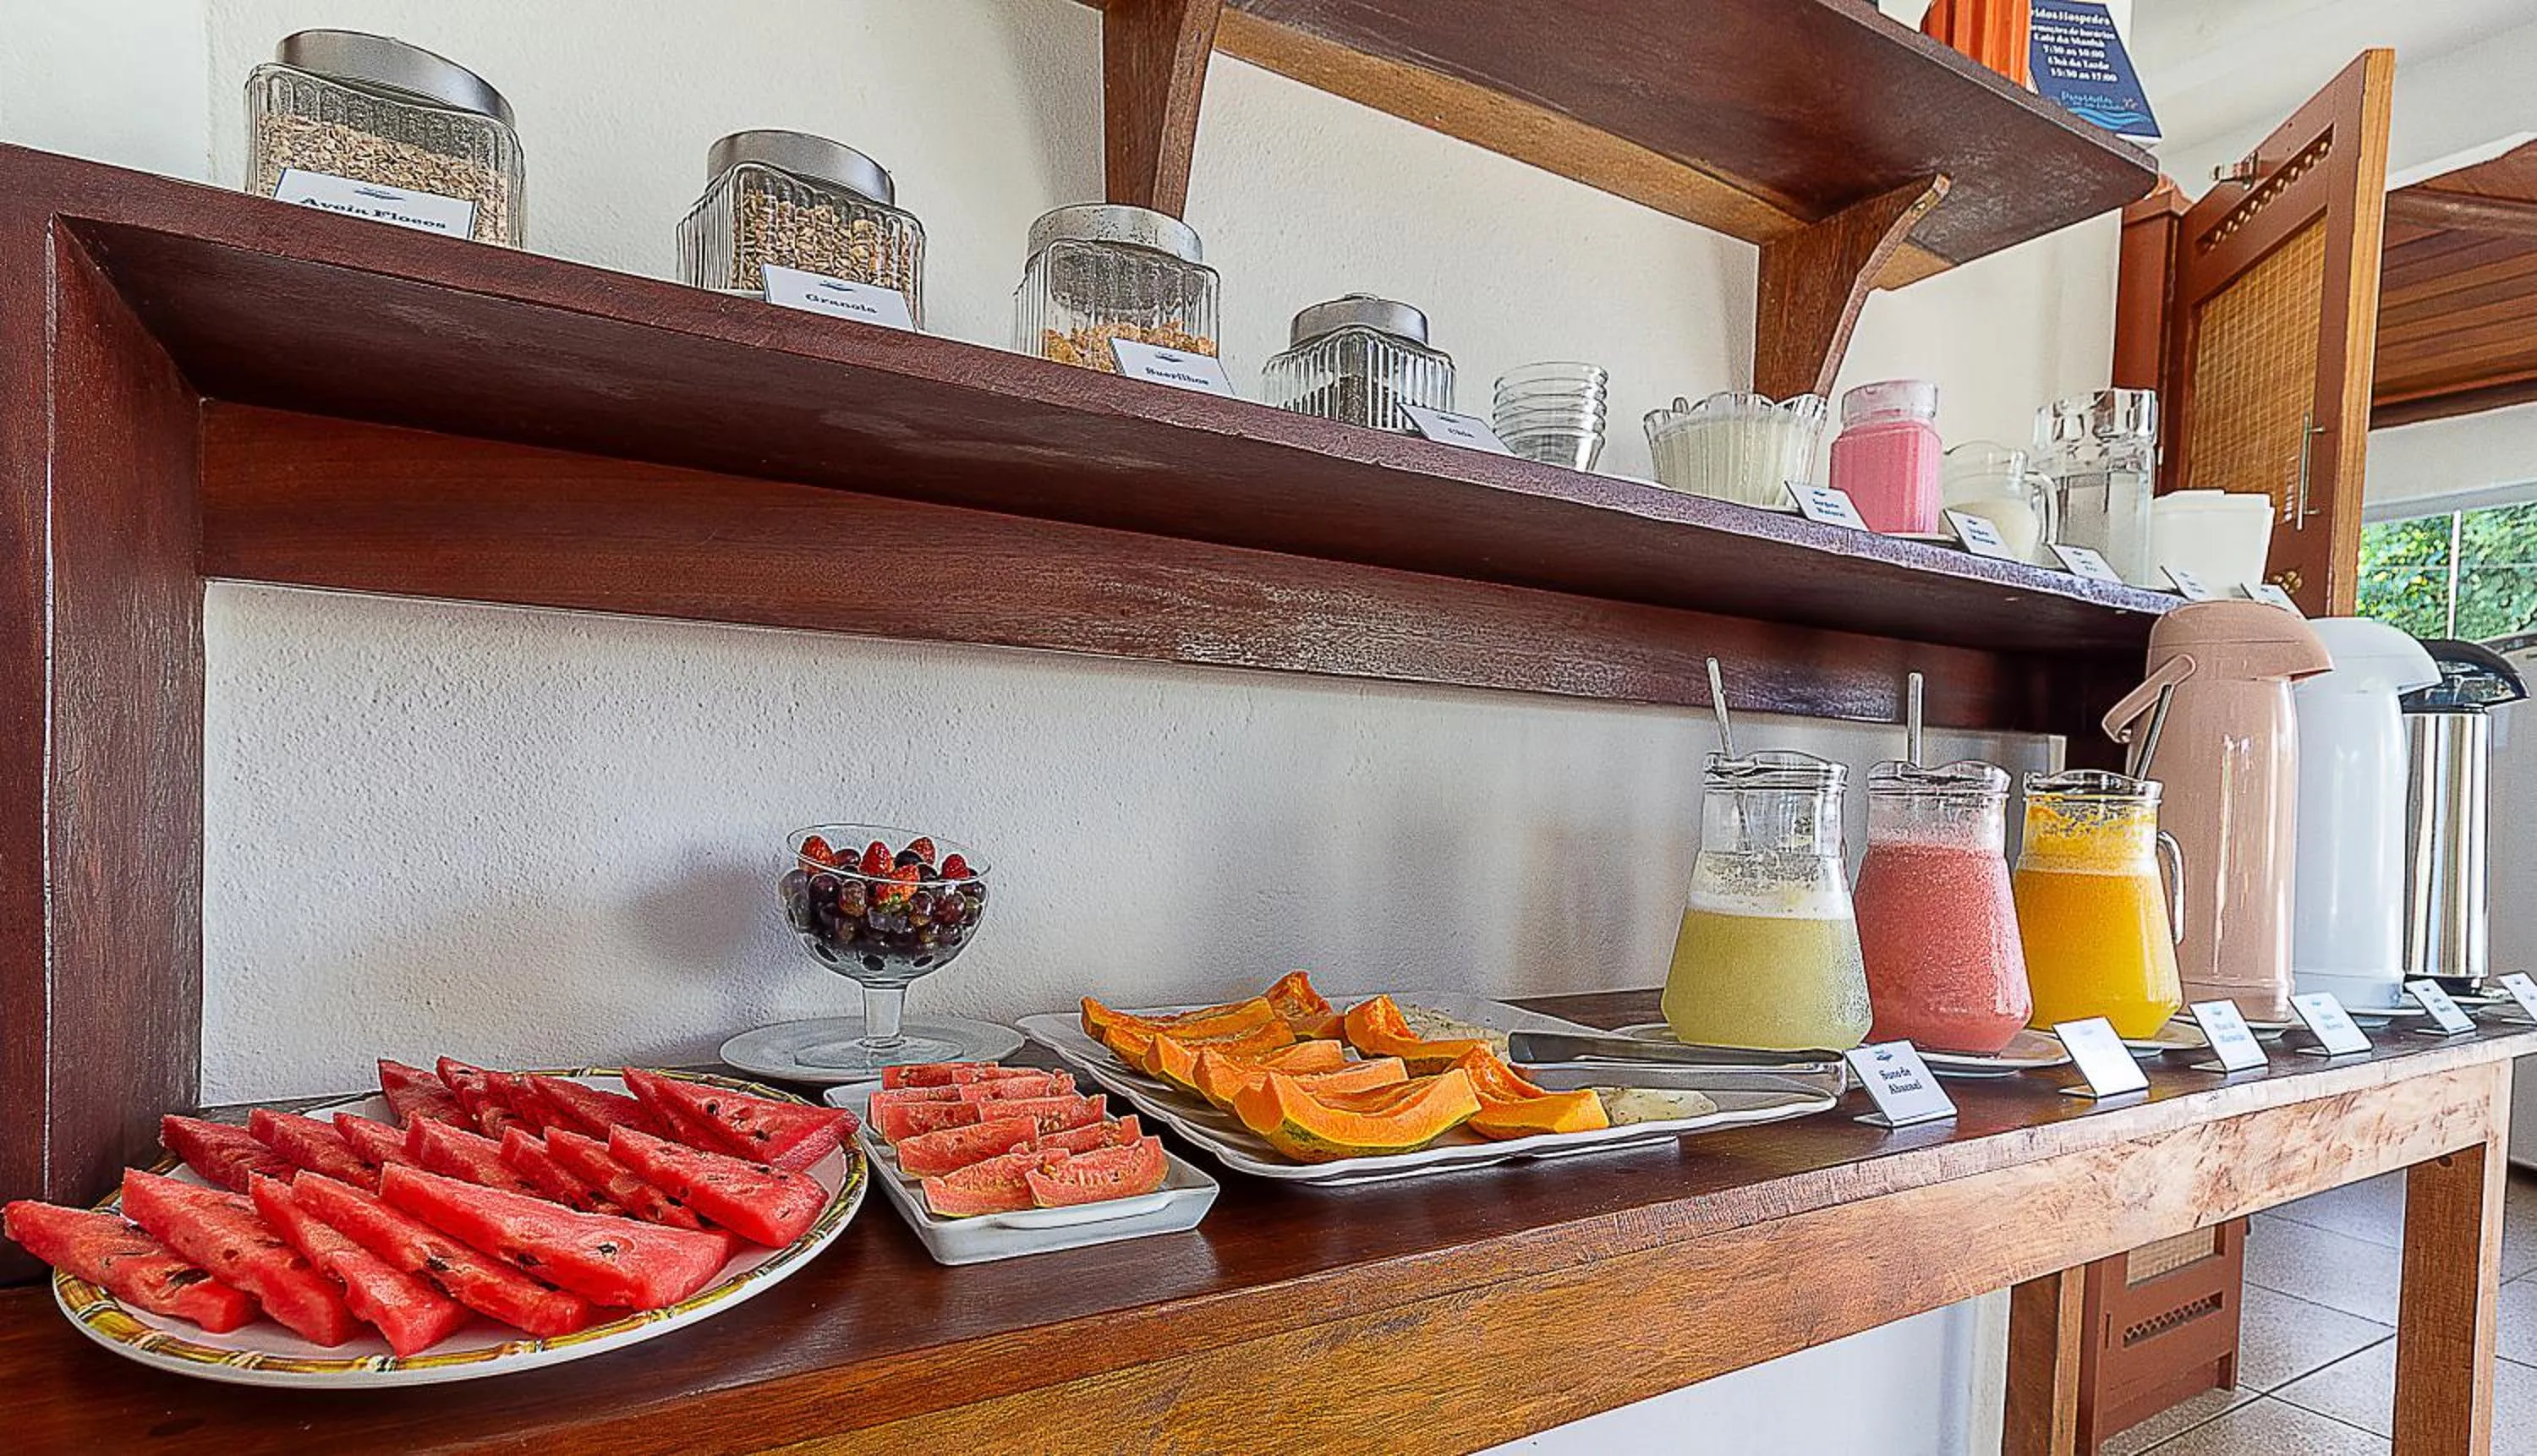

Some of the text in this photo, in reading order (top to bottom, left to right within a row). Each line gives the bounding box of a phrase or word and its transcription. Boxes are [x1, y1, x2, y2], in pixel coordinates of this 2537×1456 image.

[300, 196, 447, 229] Aveia Flocos
[805, 293, 878, 314] Granola
